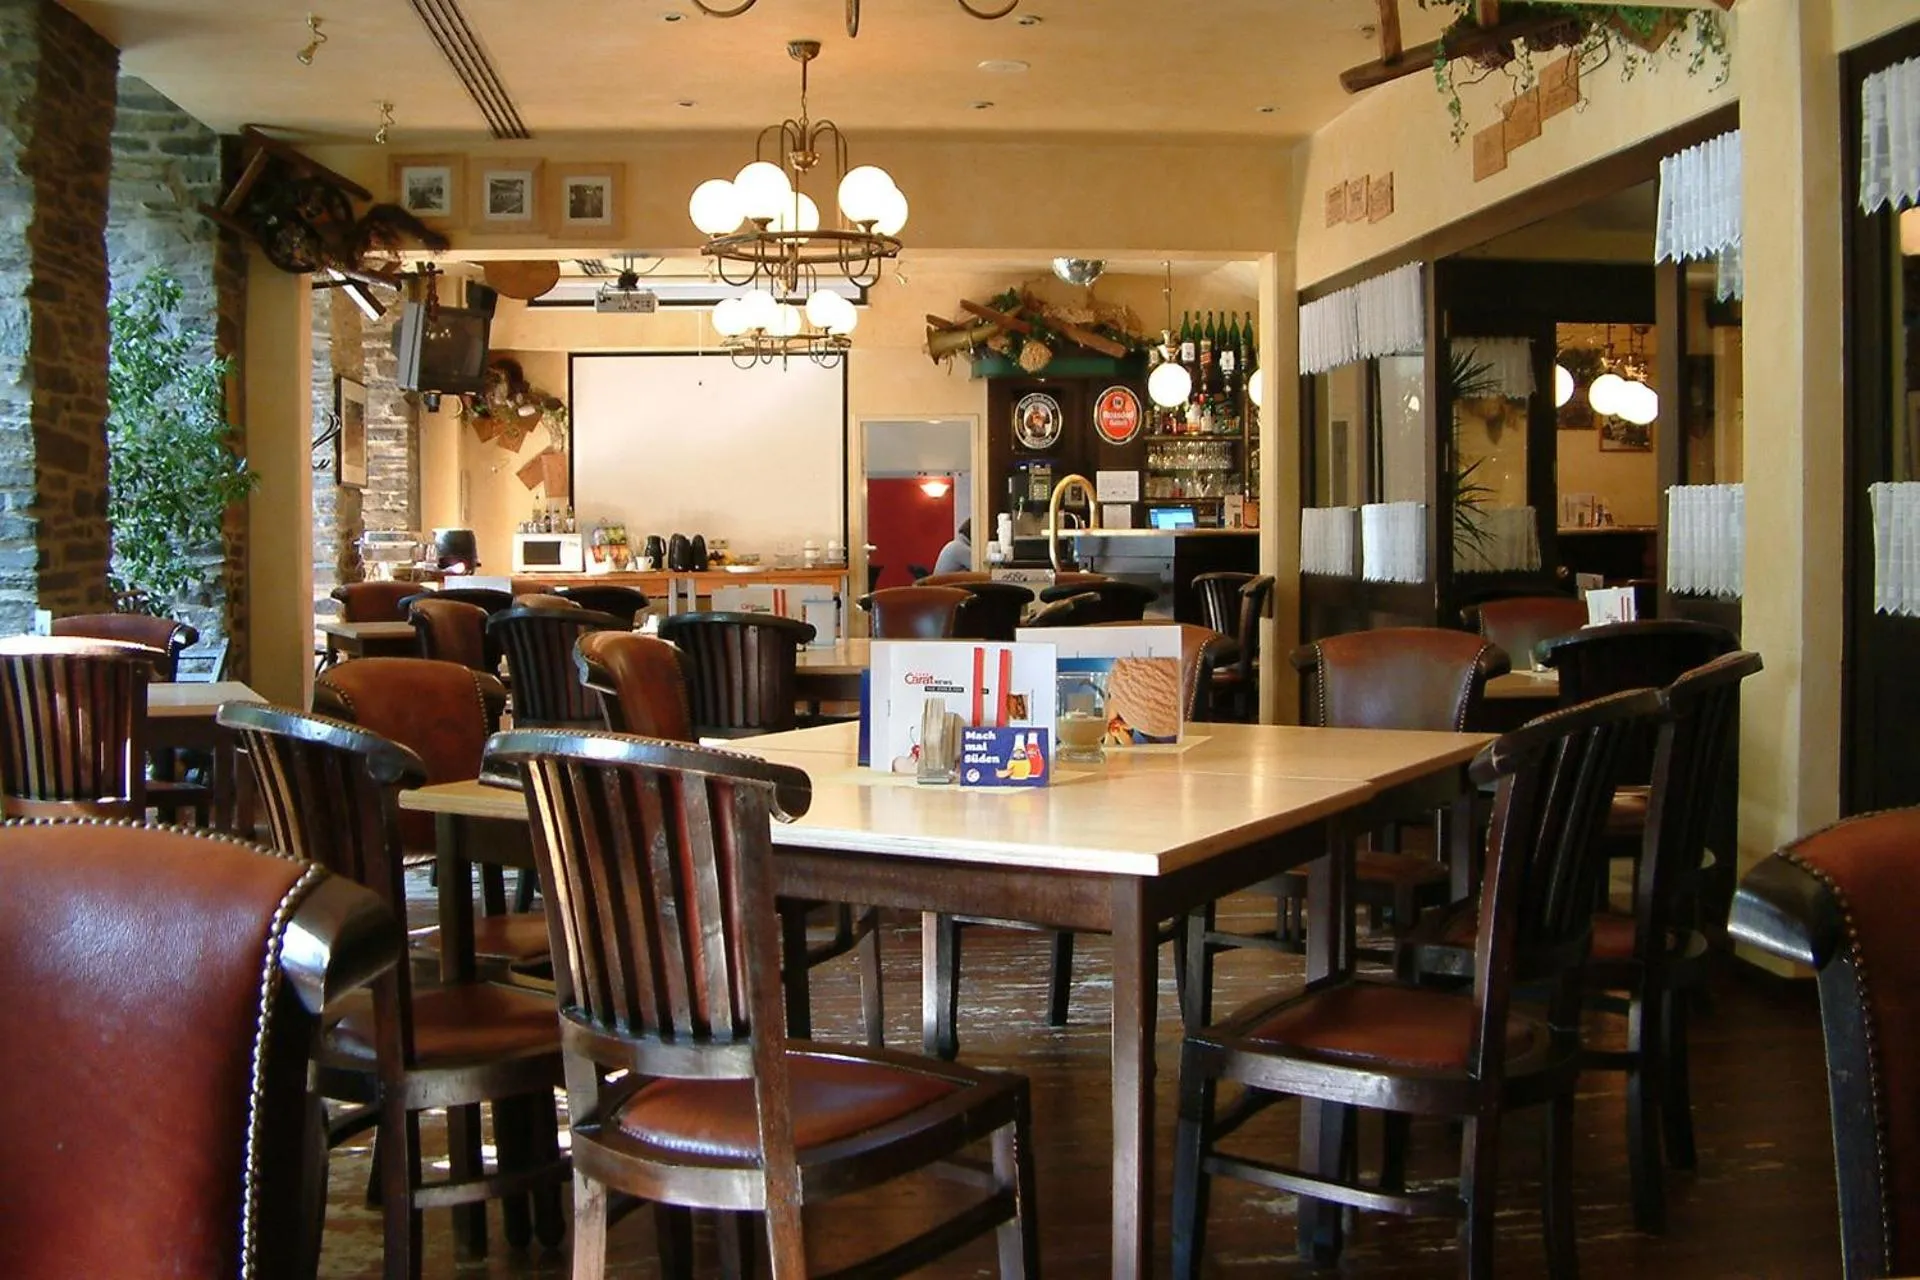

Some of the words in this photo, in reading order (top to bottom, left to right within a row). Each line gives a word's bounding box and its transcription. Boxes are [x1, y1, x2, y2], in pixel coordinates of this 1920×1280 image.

[904, 672, 934, 685] Carat
[965, 730, 996, 740] Mach
[964, 741, 988, 751] mal
[964, 753, 1000, 764] Süden
